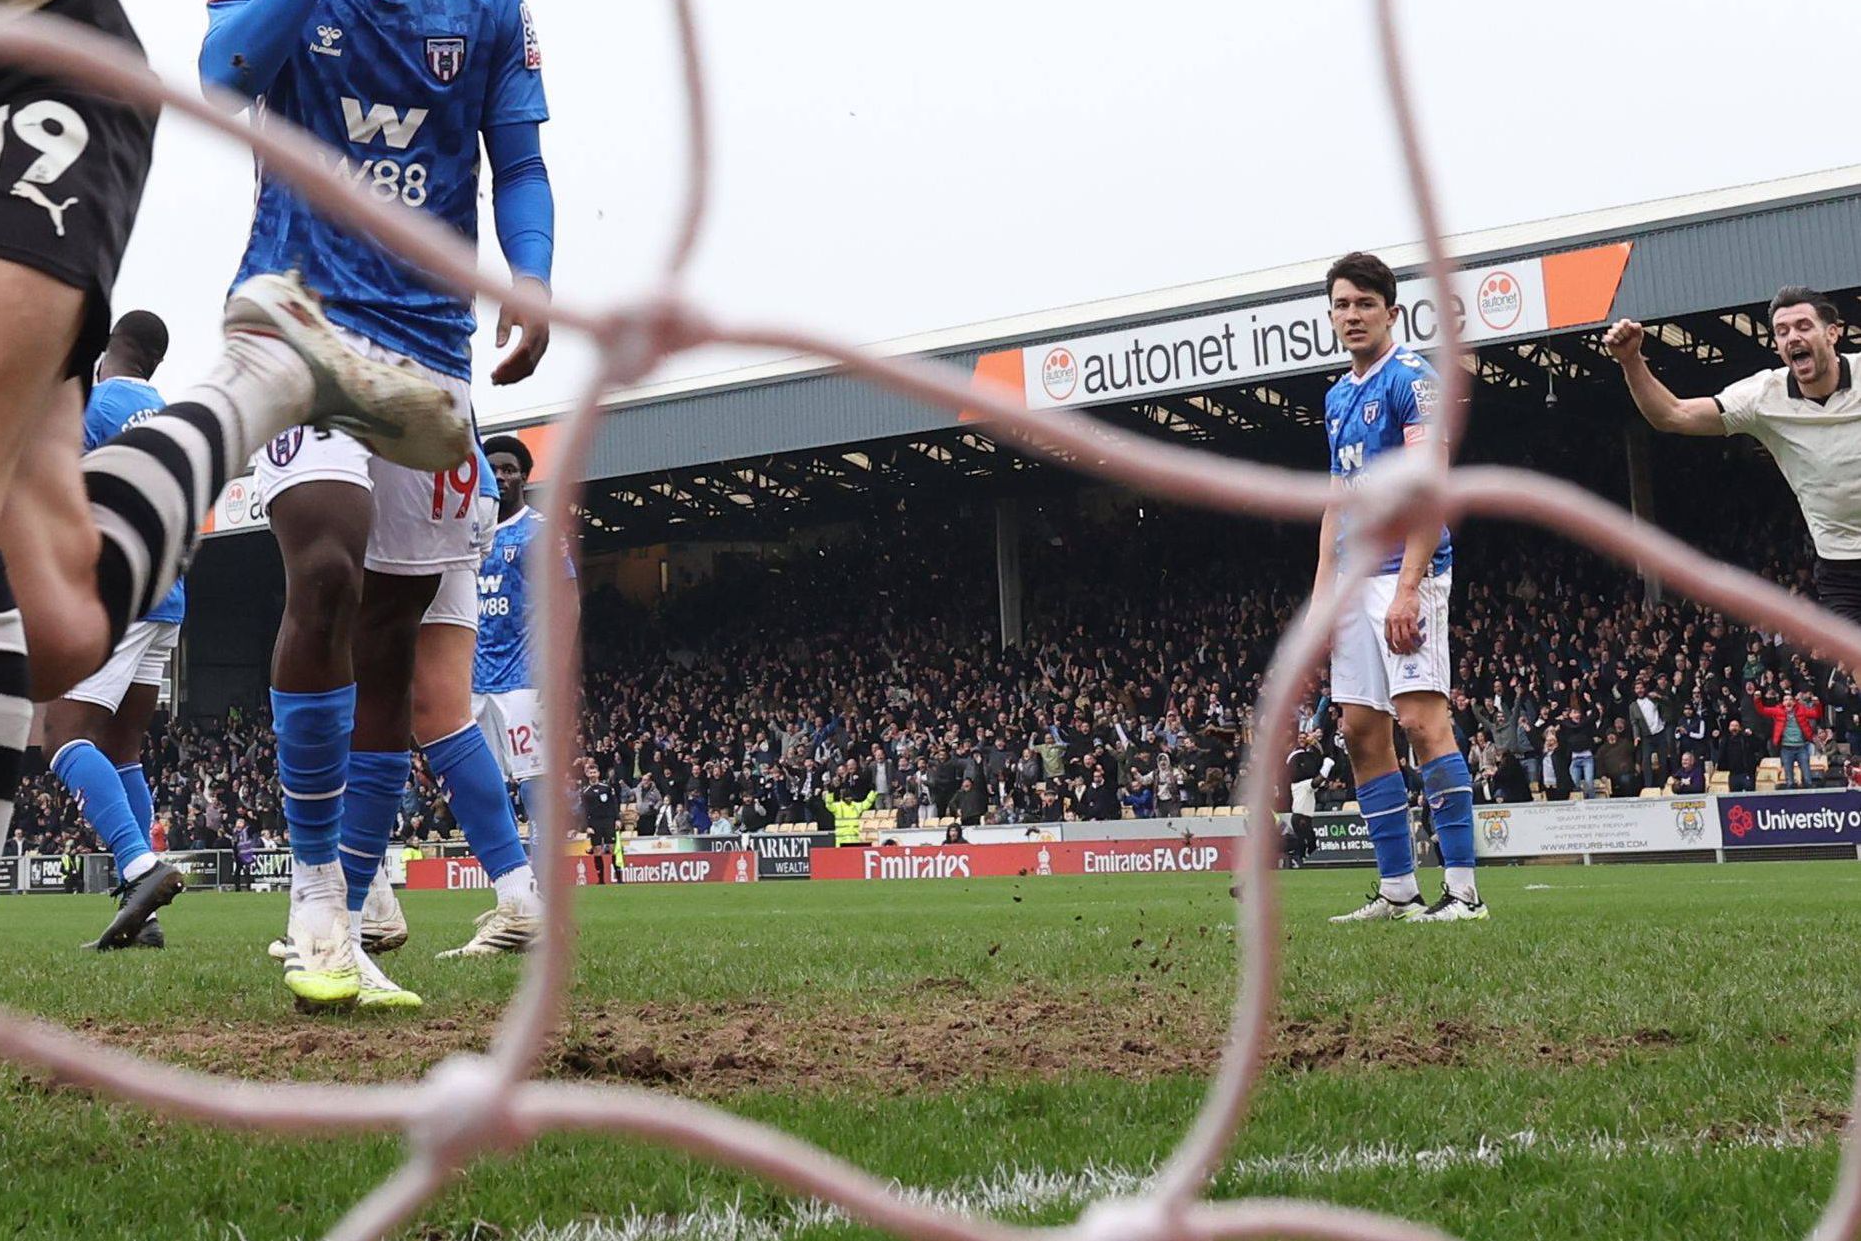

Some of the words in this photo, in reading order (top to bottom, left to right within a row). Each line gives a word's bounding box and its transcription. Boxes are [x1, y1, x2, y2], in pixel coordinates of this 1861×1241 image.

[1084, 323, 1238, 395] autonet
[1251, 293, 1466, 368] insunce
[431, 452, 479, 522] 19
[507, 724, 534, 757] 12
[1330, 824, 1347, 837] QA
[1756, 806, 1845, 834] University
[1848, 810, 1861, 828] o
[661, 862, 679, 882] FA
[679, 860, 711, 881] CUP
[775, 861, 810, 874] WEALTH
[863, 849, 970, 879] Emirates
[1083, 849, 1153, 873] Emirates
[1153, 848, 1178, 872] FA
[1178, 845, 1219, 871] CUP
